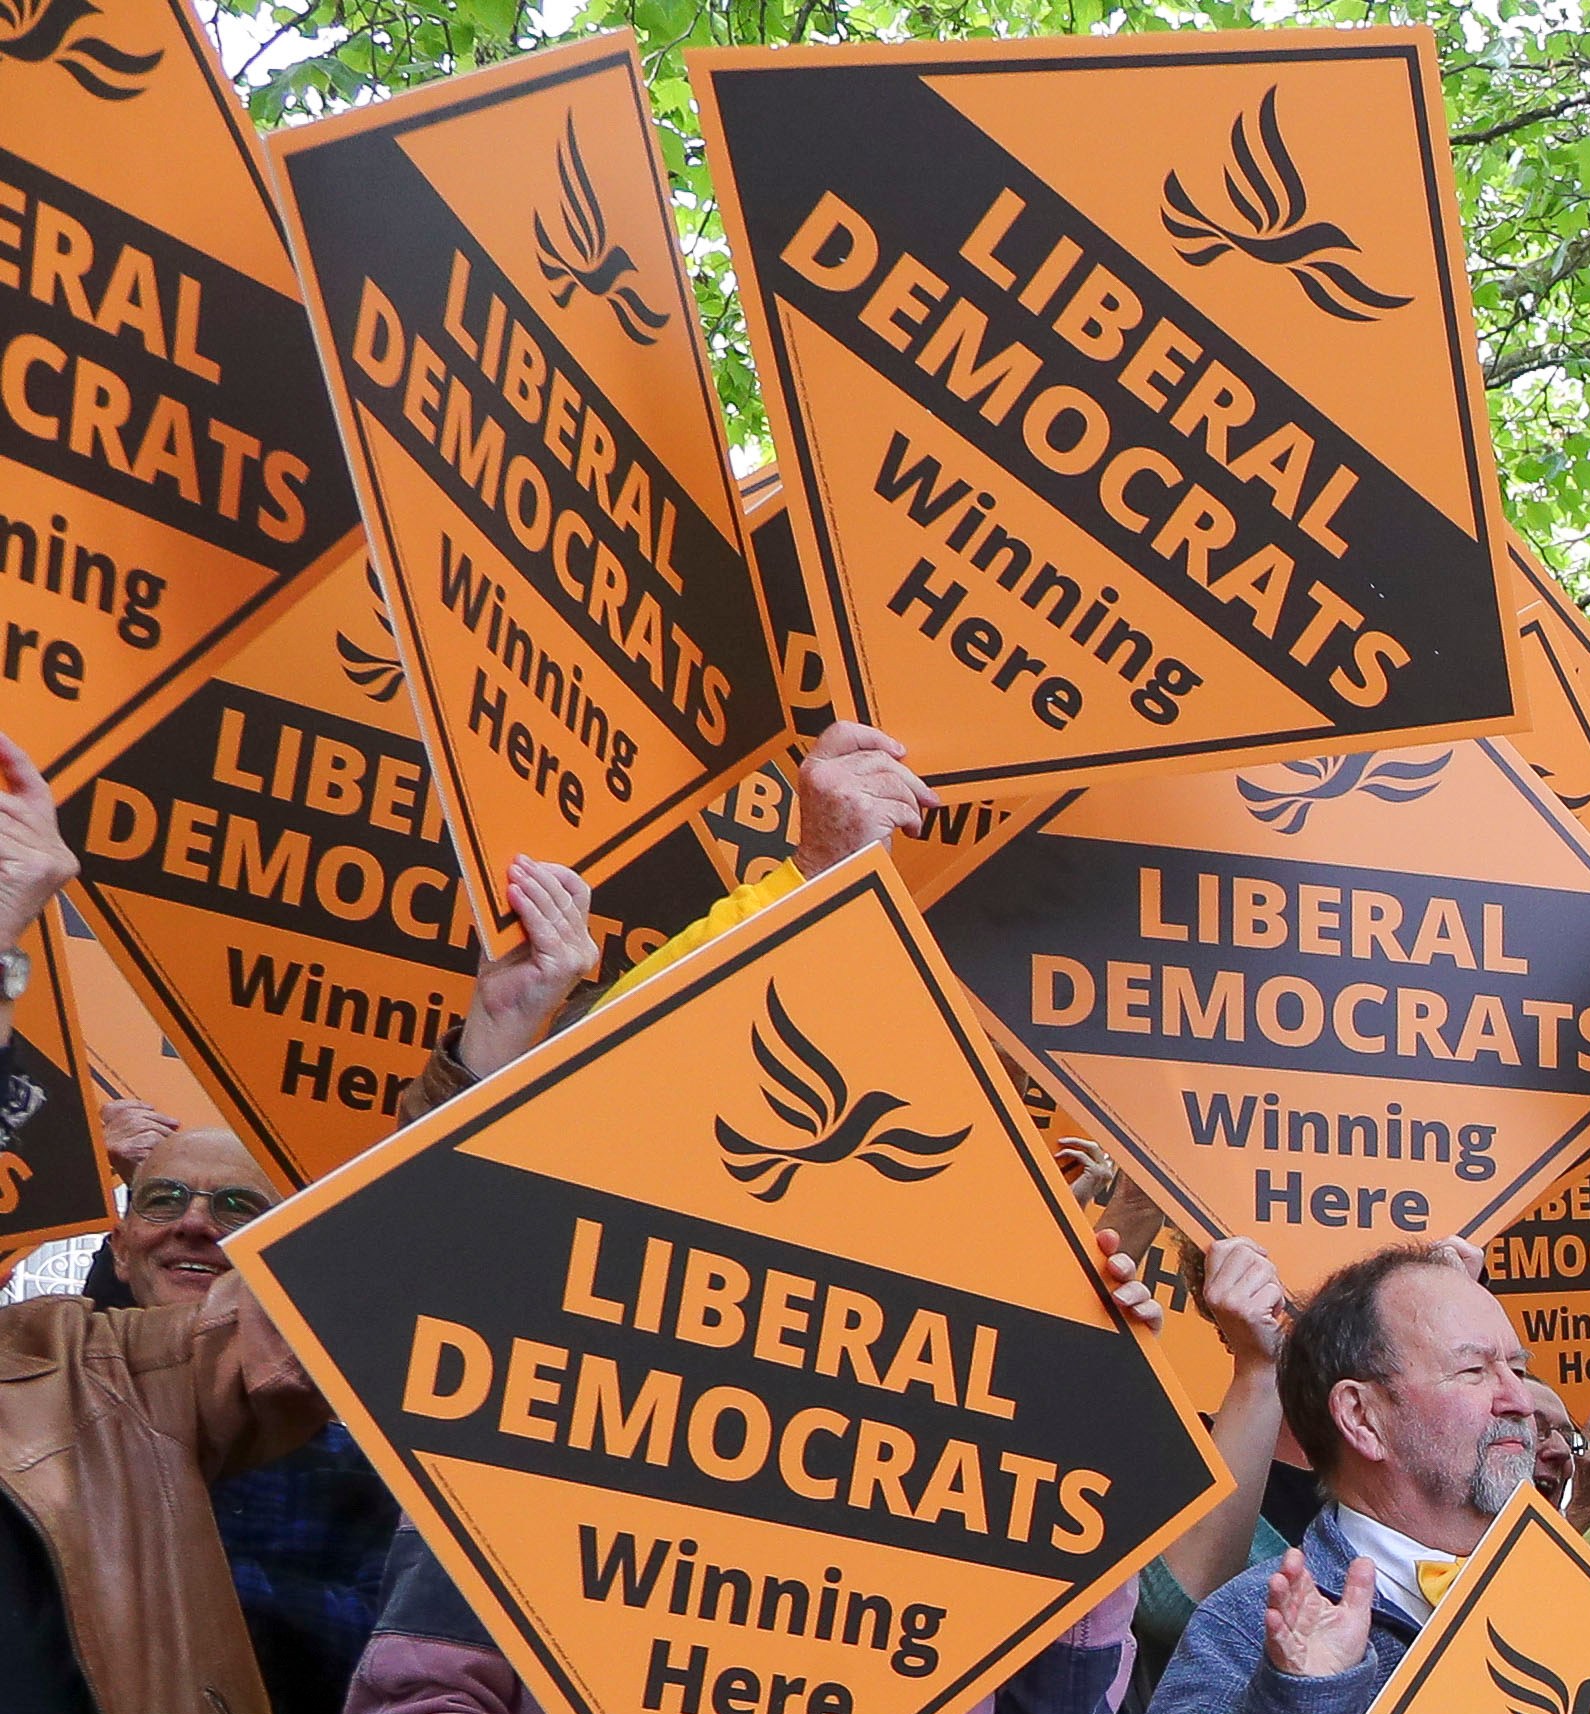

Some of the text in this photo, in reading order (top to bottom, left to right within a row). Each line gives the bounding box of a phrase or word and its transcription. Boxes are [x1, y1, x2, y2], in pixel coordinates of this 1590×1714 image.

[0, 180, 221, 385] ERAL
[1, 333, 311, 543] CRATS
[443, 248, 684, 595] LIBERAL
[780, 189, 1412, 708] DEMOCRATS
[958, 186, 1358, 560] LIBERAL
[0, 513, 166, 650] ning
[351, 276, 731, 748] DEMOCRATS
[871, 430, 1204, 727] Winning
[4, 620, 84, 700] re
[441, 531, 637, 802] Winning
[886, 557, 1085, 732] Here
[212, 707, 447, 845] LIBE
[468, 667, 586, 828] Here
[227, 946, 465, 1051] Winni
[1138, 866, 1528, 975] LIBERAL
[280, 1040, 410, 1118] Her
[1181, 1090, 1498, 1181] Winning
[1254, 1168, 1430, 1232] Here
[561, 1217, 1016, 1421] LIBERAL
[402, 1314, 1113, 1557] DEMOCRATS
[578, 1523, 948, 1678] Winning
